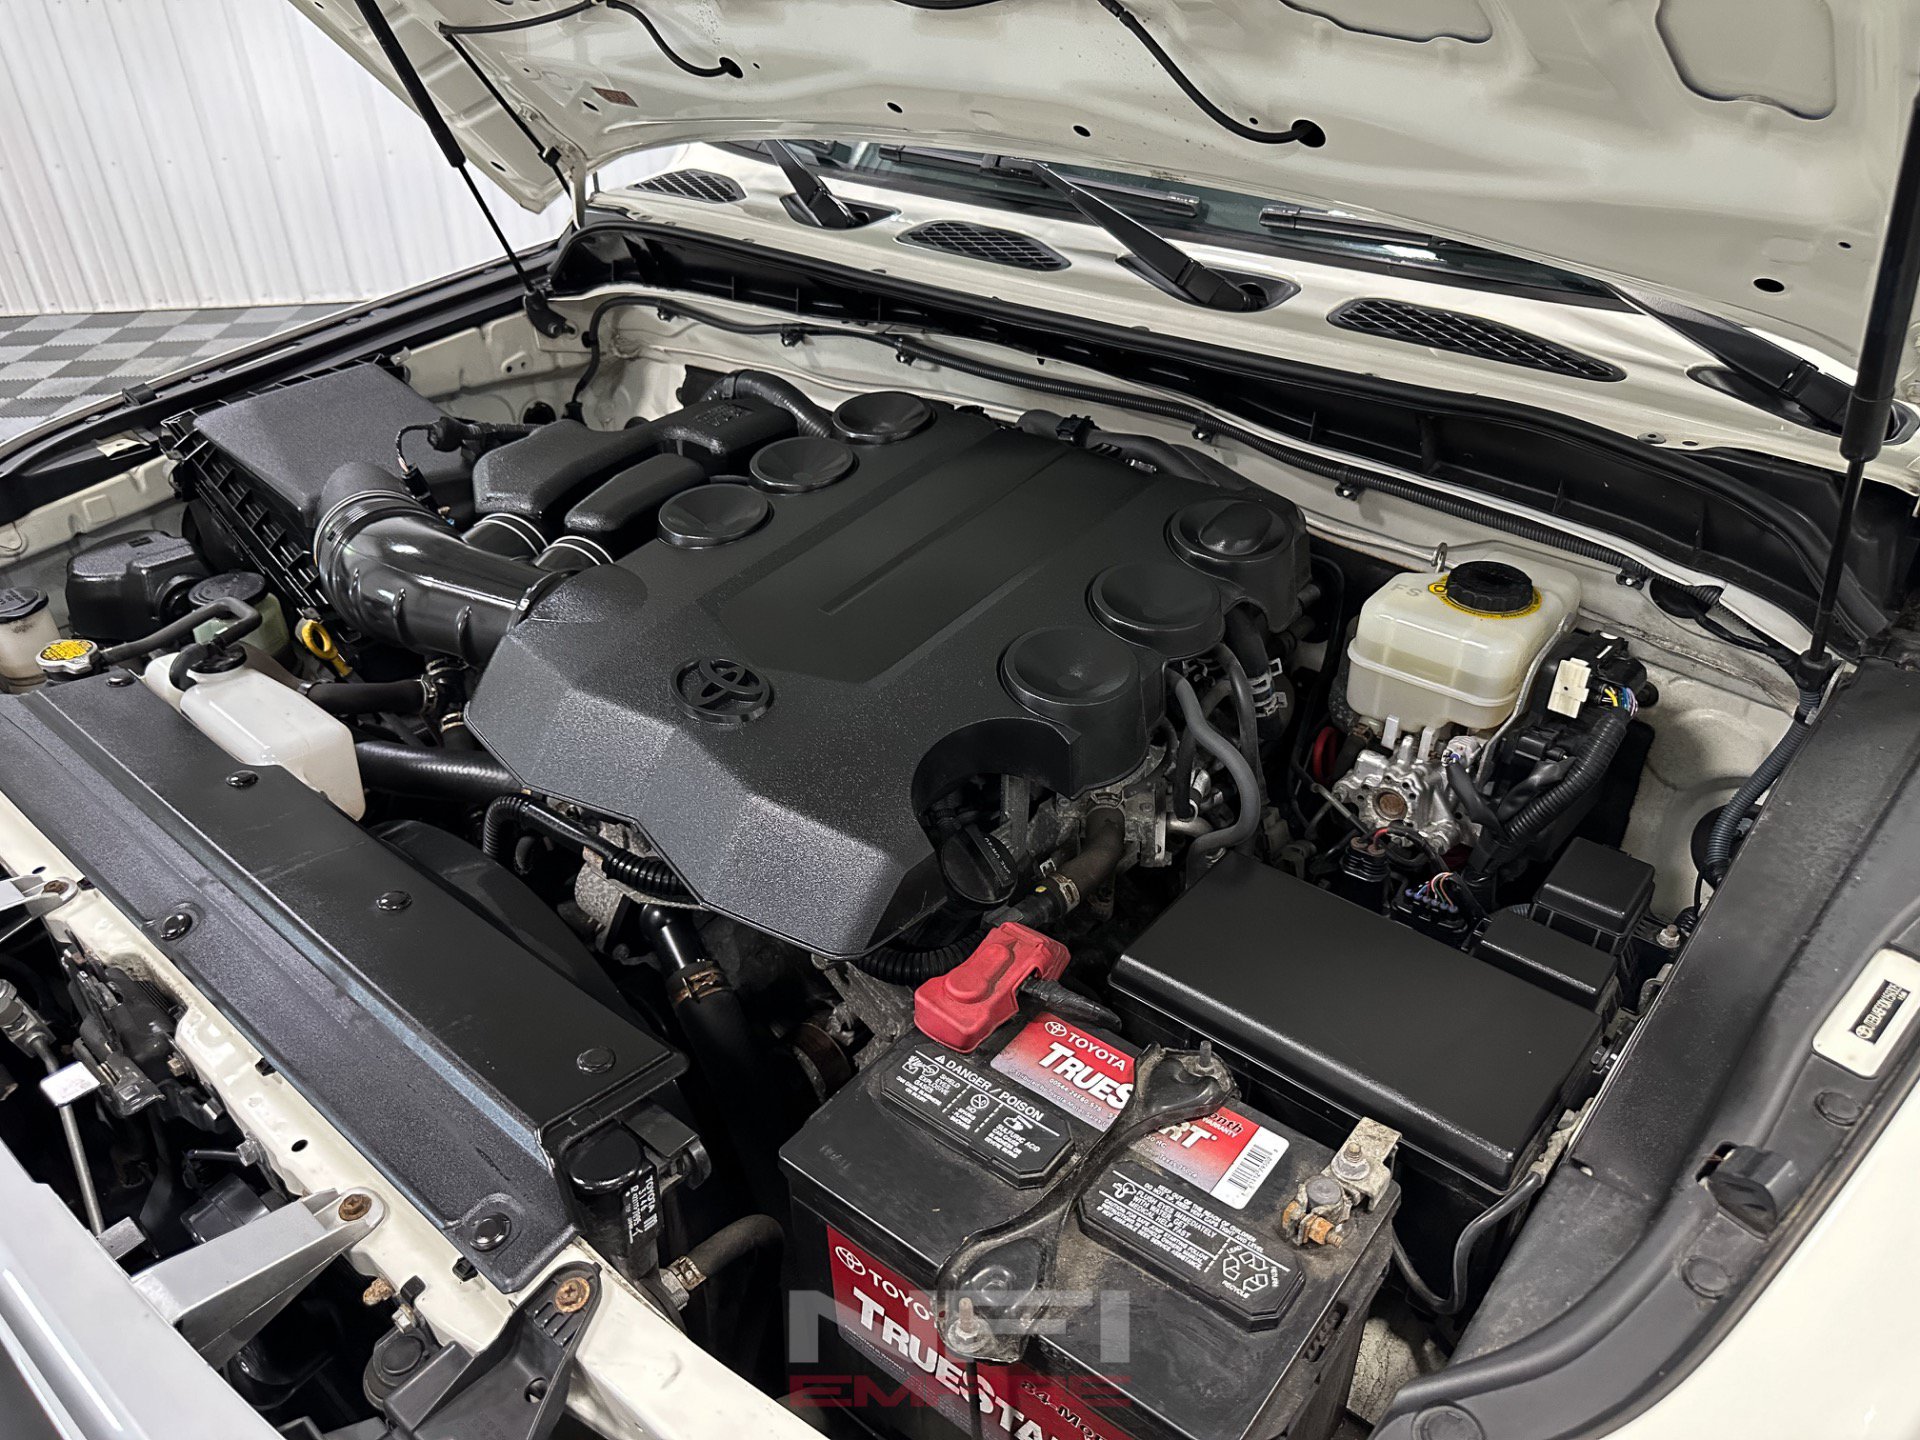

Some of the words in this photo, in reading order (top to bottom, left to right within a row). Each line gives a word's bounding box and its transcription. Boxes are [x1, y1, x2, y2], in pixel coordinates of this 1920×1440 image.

[1066, 1031, 1126, 1072] TOYOTA
[913, 1079, 934, 1094] GASES
[917, 1075, 949, 1096] EXPLOSIVE
[934, 1078, 951, 1090] EYES
[938, 1073, 961, 1089] SHIELD
[945, 1060, 992, 1091] DANGER
[998, 1091, 1045, 1121] POISON
[965, 1105, 977, 1114] NO
[1210, 1110, 1244, 1134] onth
[995, 1124, 1026, 1143] SULFURIC
[1024, 1141, 1041, 1153] ACID
[645, 1175, 656, 1213] TOYOTA
[1128, 1200, 1156, 1219] MEDICAL
[1155, 1216, 1173, 1228] HELP
[1172, 1226, 1191, 1239] FAST
[1132, 1195, 1150, 1208] WITH
[1173, 1219, 1188, 1230] GET
[1136, 1190, 1158, 1205] FLUSH
[1157, 1202, 1175, 1214] EYES
[1174, 1211, 1217, 1239] IMMEDIATELY
[1222, 1280, 1250, 1298] RECYCLE
[852, 1287, 1062, 1440] TRUESTA
